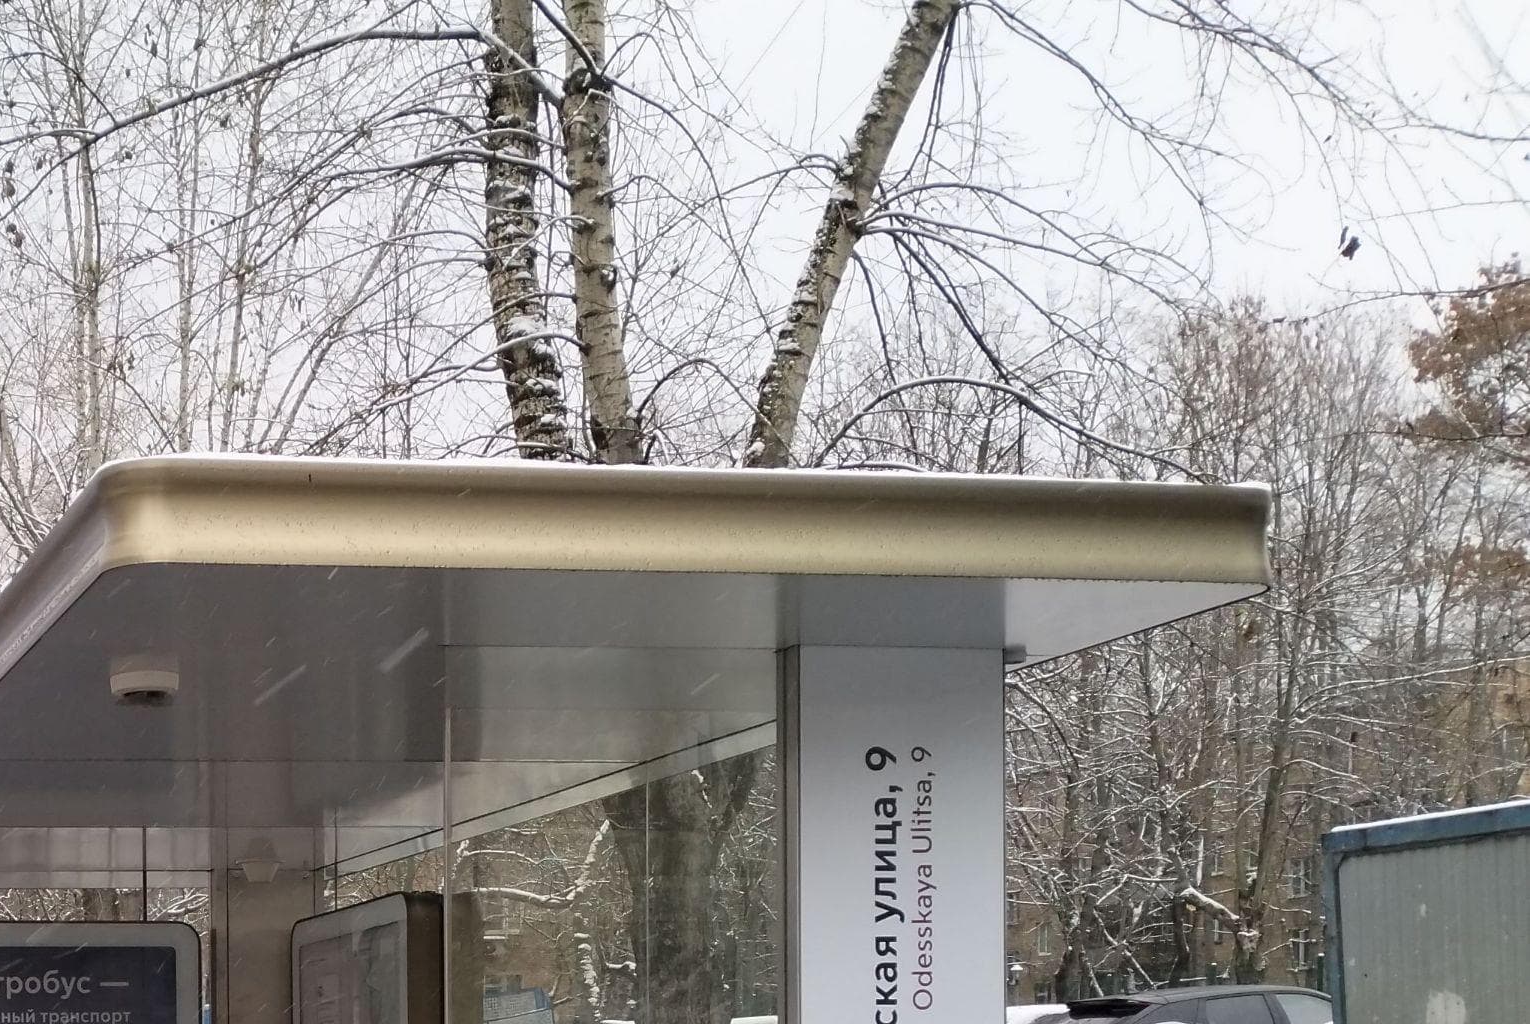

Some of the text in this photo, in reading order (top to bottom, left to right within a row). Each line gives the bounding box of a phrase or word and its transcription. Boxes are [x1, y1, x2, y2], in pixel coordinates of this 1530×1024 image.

[865, 746, 897, 771] 9
[874, 785, 905, 923] улица,
[910, 746, 937, 1010] Odesskaya Ulitsa, 9
